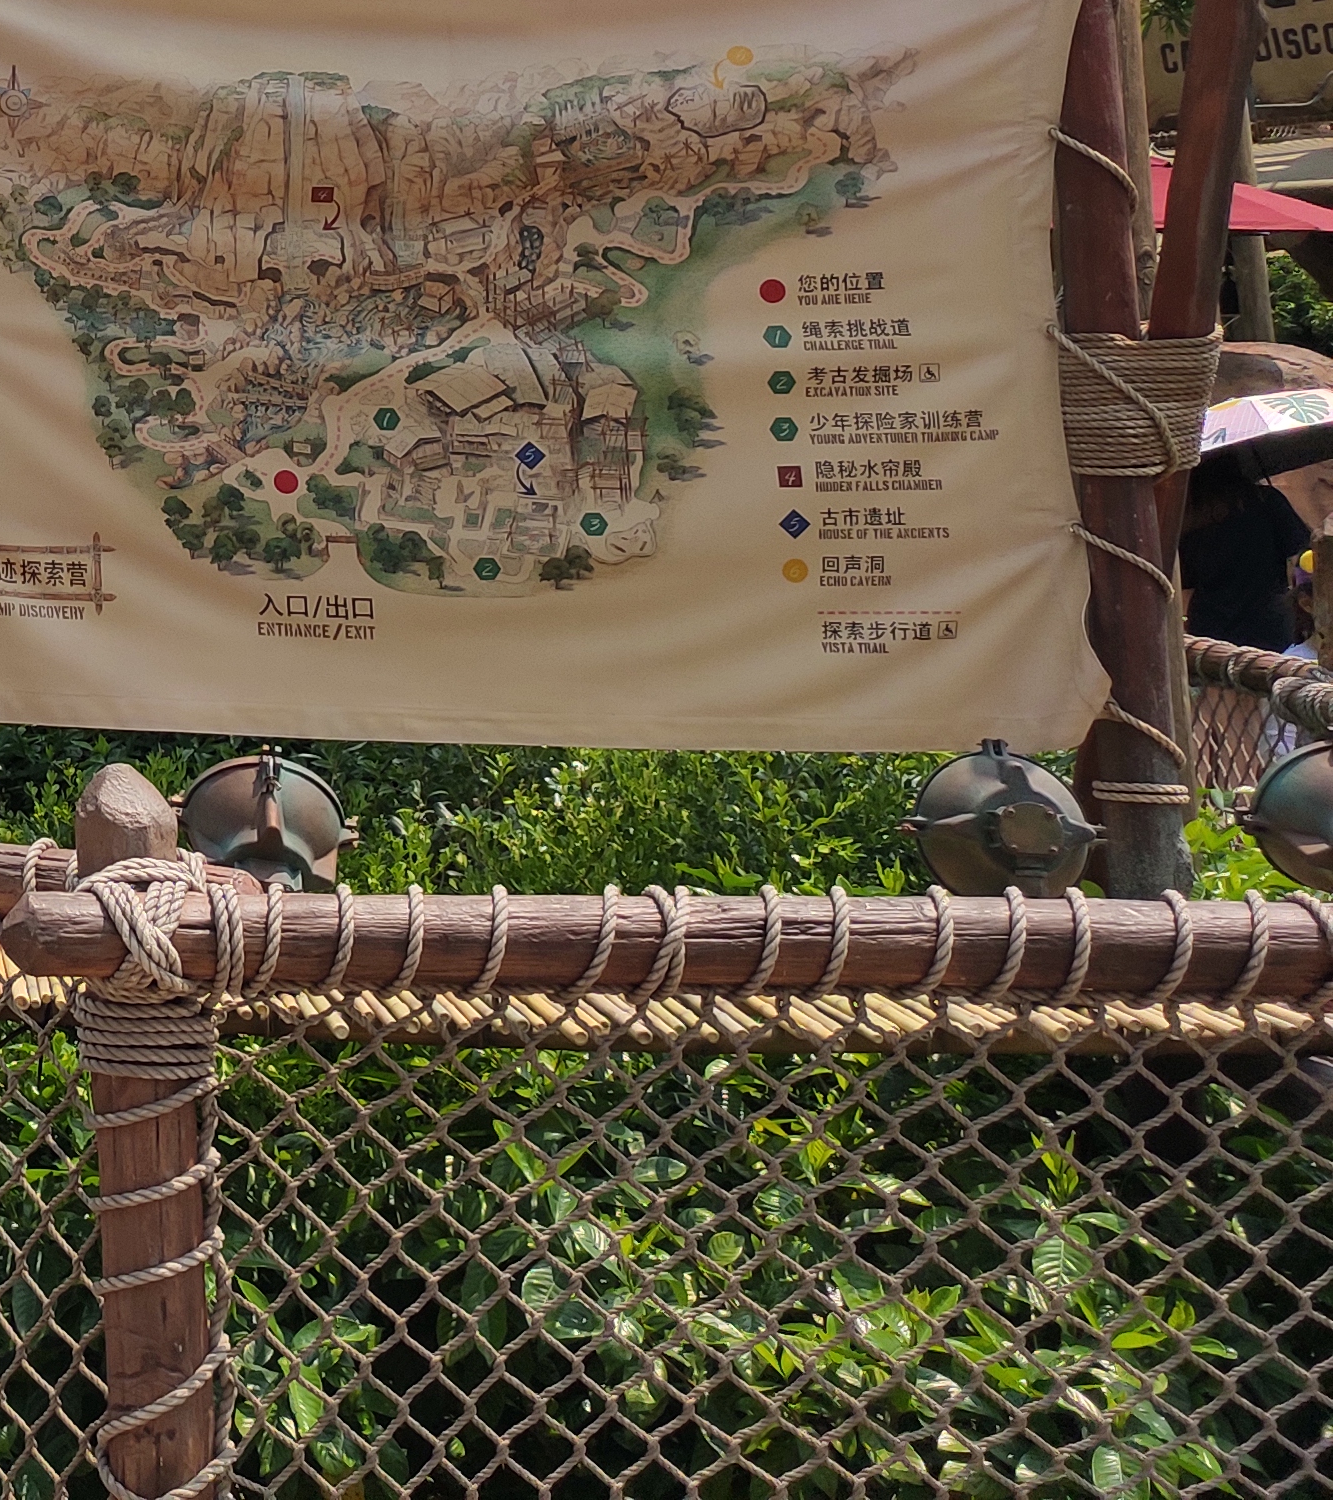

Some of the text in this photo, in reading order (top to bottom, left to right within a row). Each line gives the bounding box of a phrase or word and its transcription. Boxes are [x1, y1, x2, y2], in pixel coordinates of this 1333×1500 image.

[798, 272, 885, 292] 您的位置
[797, 293, 872, 306] YOU ARE HERE
[801, 318, 911, 339] 绳索挑战道
[803, 338, 898, 351] CHALLENGE TRAIL
[776, 376, 787, 389] 2
[807, 365, 913, 385] 考古发掘场
[805, 385, 899, 398] EXCAVATION SITE
[383, 412, 391, 428] 1
[809, 410, 984, 432] 少年探险家训练营
[778, 423, 790, 436] 3
[809, 429, 999, 445] YOUNG ADVENTURER TRAINING CAMP
[524, 448, 536, 463] 5
[815, 459, 923, 480] 隐秘水帘殿
[785, 471, 796, 485] 4
[815, 479, 943, 492] HIDDEN FALLS CHAMBER
[589, 518, 601, 531] 3
[788, 517, 800, 532] 5
[819, 507, 907, 527] 古市遗址
[819, 526, 950, 540] HOUSE OF THE ANCIENTS
[482, 563, 493, 576] 2
[821, 555, 885, 575] 回声洞
[819, 575, 892, 587] ECHO CAVERN
[19, 603, 85, 620] DISCOVERY
[259, 593, 374, 620] 入口/出口
[257, 621, 376, 640] ENTRANCE/EXIT
[821, 620, 933, 641] 探索步行道
[821, 641, 890, 654] VISTA TRAIL
